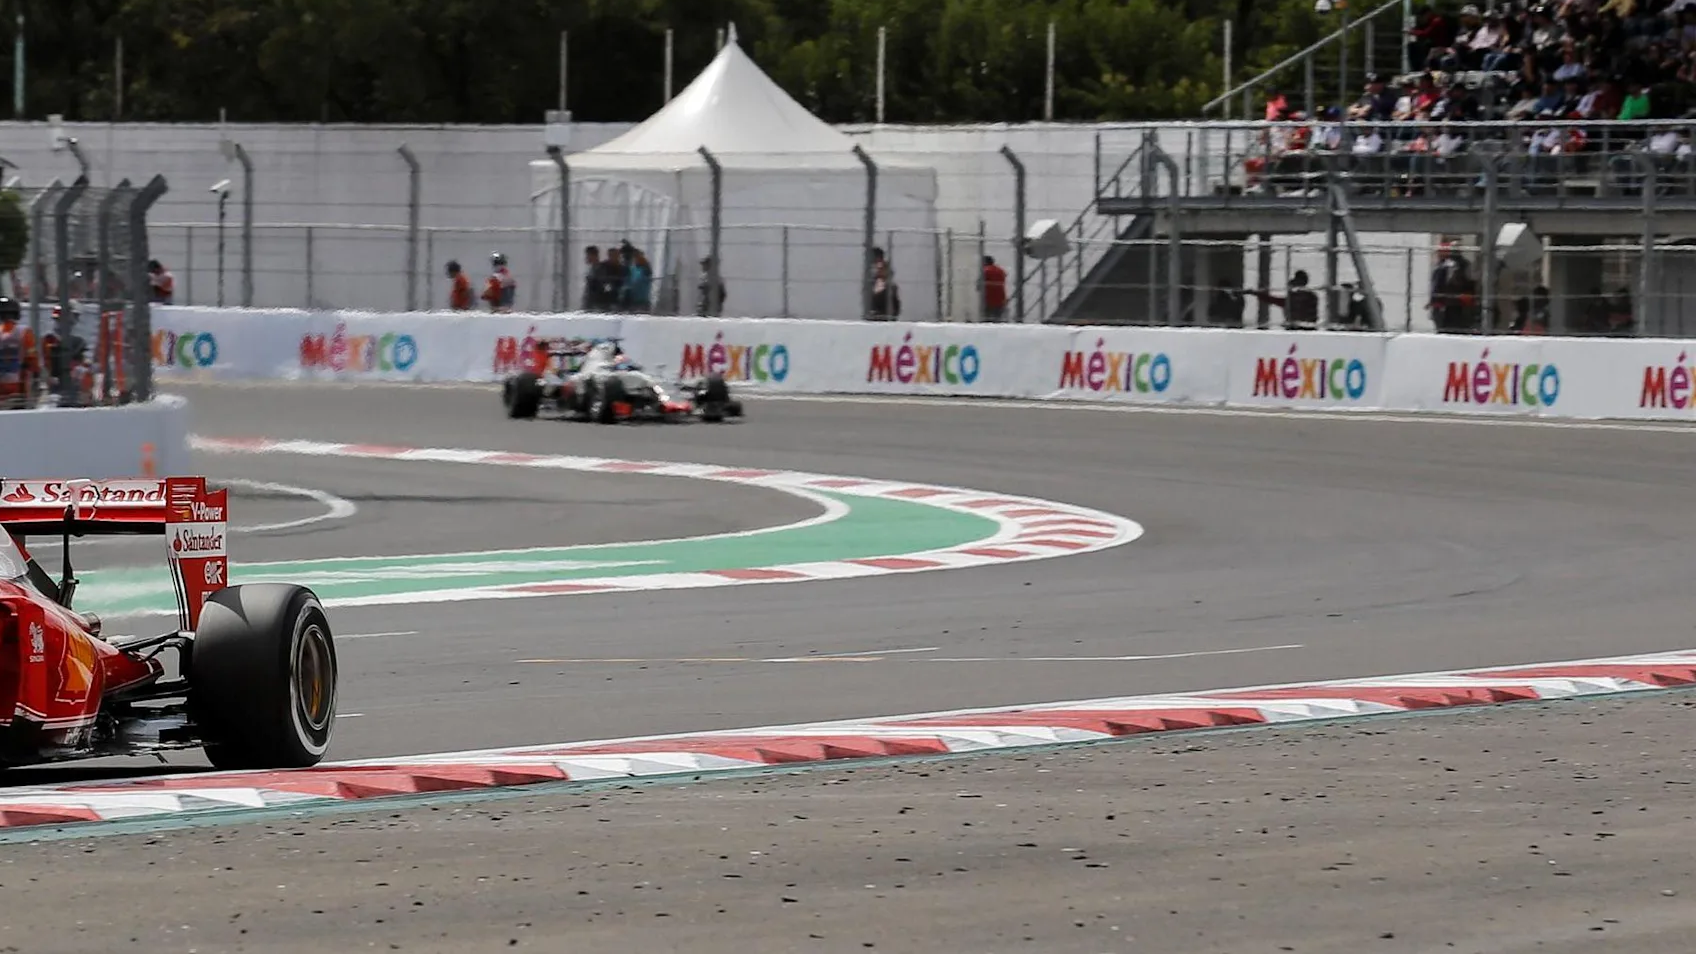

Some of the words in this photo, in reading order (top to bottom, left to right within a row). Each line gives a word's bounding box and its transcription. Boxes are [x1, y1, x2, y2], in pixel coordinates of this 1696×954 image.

[40, 482, 166, 504] Santand
[190, 501, 223, 521] V-Power
[182, 526, 224, 552] Santander
